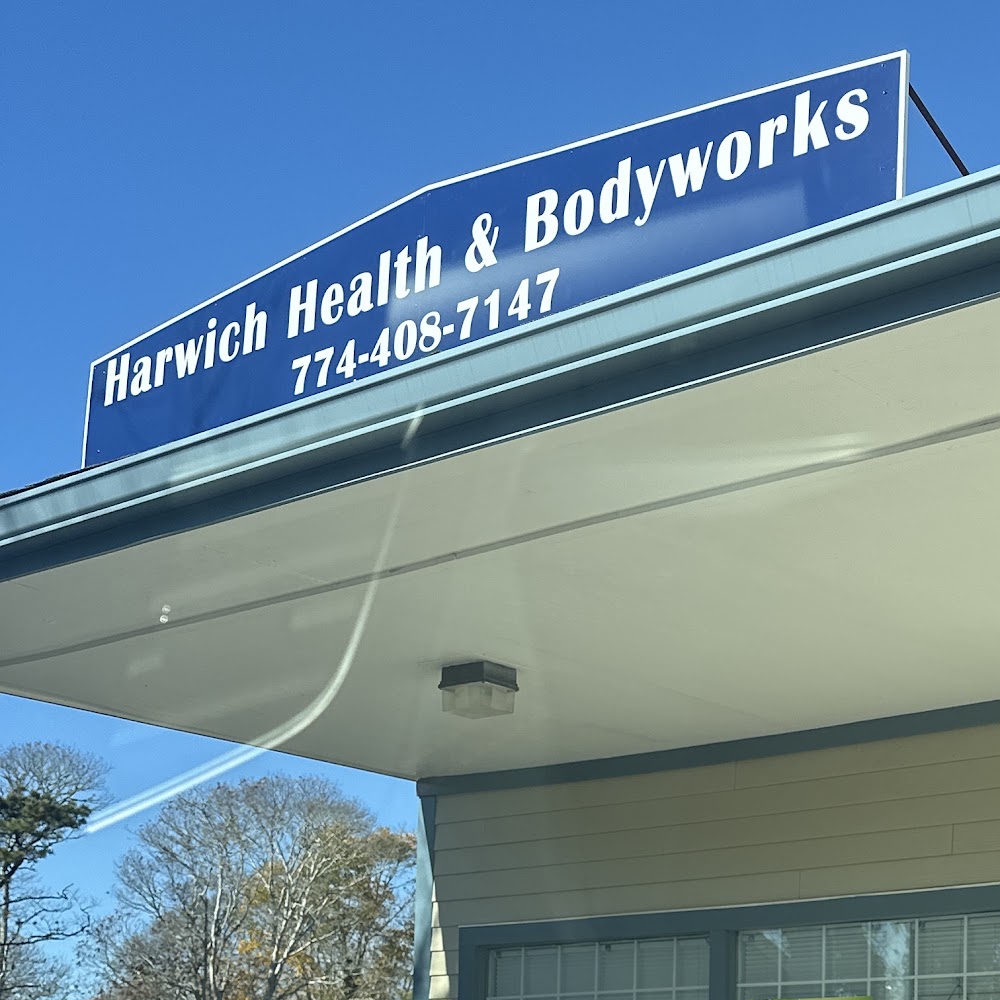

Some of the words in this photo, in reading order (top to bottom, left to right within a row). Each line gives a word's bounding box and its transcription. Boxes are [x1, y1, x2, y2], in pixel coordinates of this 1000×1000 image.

[104, 302, 267, 407] Harwich
[287, 235, 442, 339] Health
[464, 212, 500, 273] &
[524, 88, 870, 253] Bodyworks
[291, 268, 561, 396] 774-408-7147
